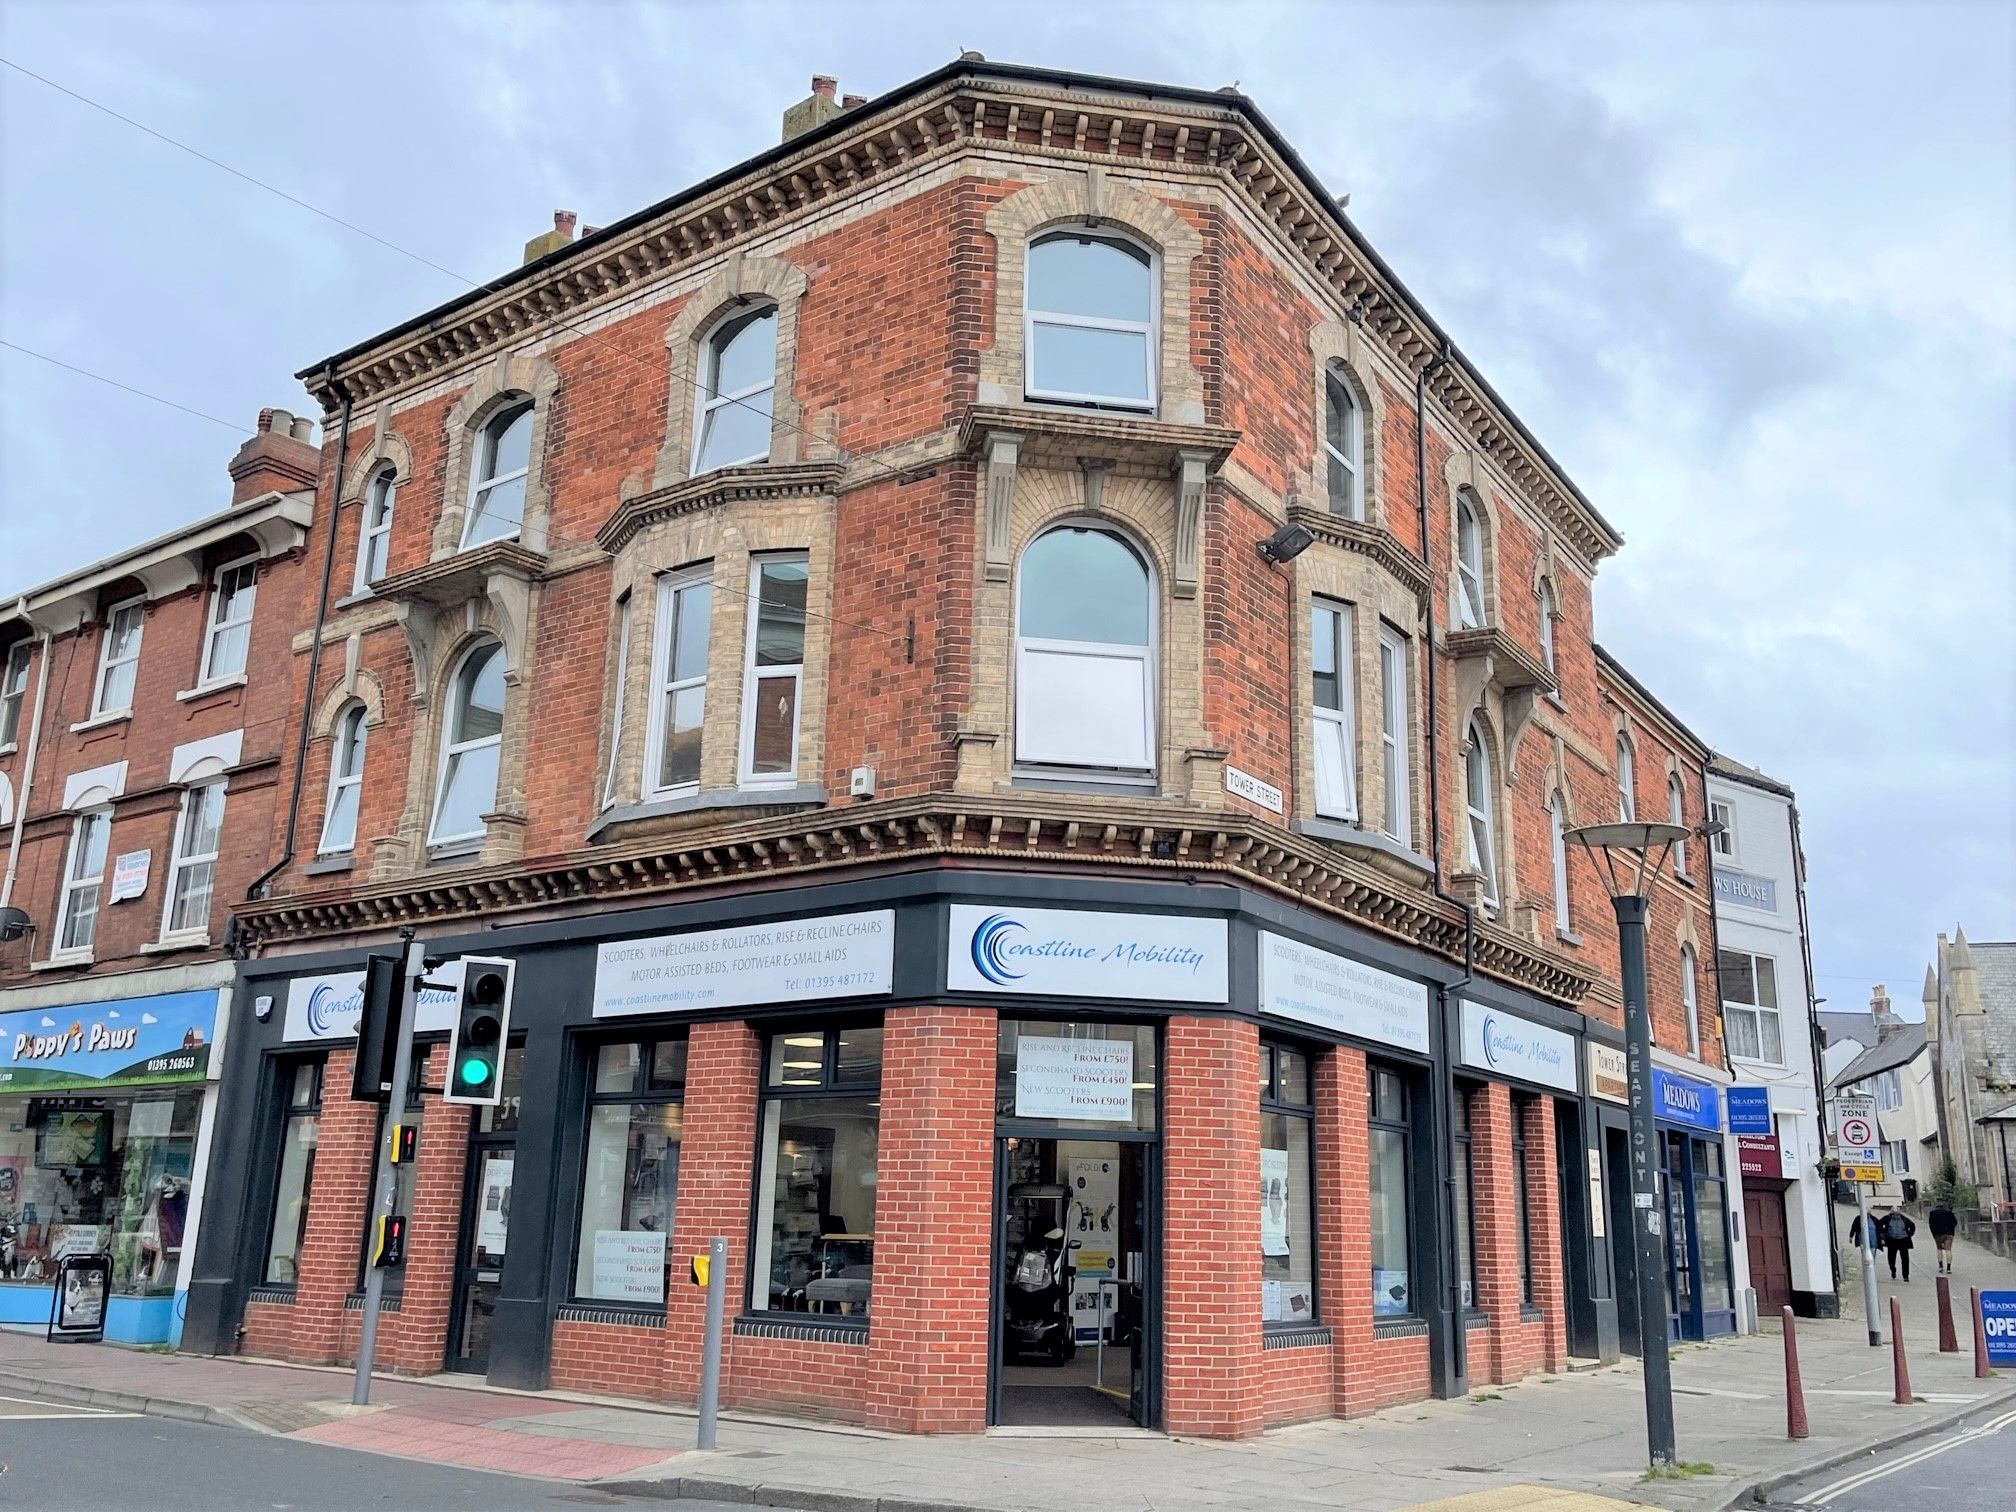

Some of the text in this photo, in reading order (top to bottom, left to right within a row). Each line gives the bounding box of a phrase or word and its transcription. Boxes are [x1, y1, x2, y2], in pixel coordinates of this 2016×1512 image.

[1230, 772, 1280, 806] TOWER STREET
[1713, 876, 1767, 901] WS HOUSE
[604, 921, 882, 963] SCOOTERS, WHEELCHAIRS & ROLLATORS, RISE & RECLINE CHAIRS
[971, 912, 1204, 987] Coastline Mobility
[631, 948, 847, 981] MOTOR ASSISTED BEDS, FOOTWEAR & SMALL AIDS
[805, 976, 835, 989] 01395
[838, 972, 874, 986] 487172
[605, 988, 714, 1007] www.coastlinemobility.com
[88, 1023, 138, 1051] Paws
[1022, 1043, 1037, 1053] RISE
[1040, 1044, 1060, 1052] AND
[1098, 1047, 1129, 1055] CHAIRS
[1528, 1041, 1560, 1072] Mobility
[148, 1057, 195, 1071] 01395 260563
[1074, 1054, 1129, 1064] FROM £750!
[1616, 1055, 1627, 1076] STR
[1021, 1065, 1128, 1077] SECONDHAND SCOOTERS
[1073, 1075, 1127, 1085] FROM £450!
[1021, 1084, 1091, 1096] NEW SCOOTERS
[1663, 1083, 1701, 1113] MEADOWS
[1071, 1096, 1128, 1106] FROM £900!
[386, 1135, 392, 1144] 2
[717, 1243, 723, 1253] 3
[1984, 1302, 2016, 1310] MEADOW
[1985, 1317, 2016, 1337] OPE
